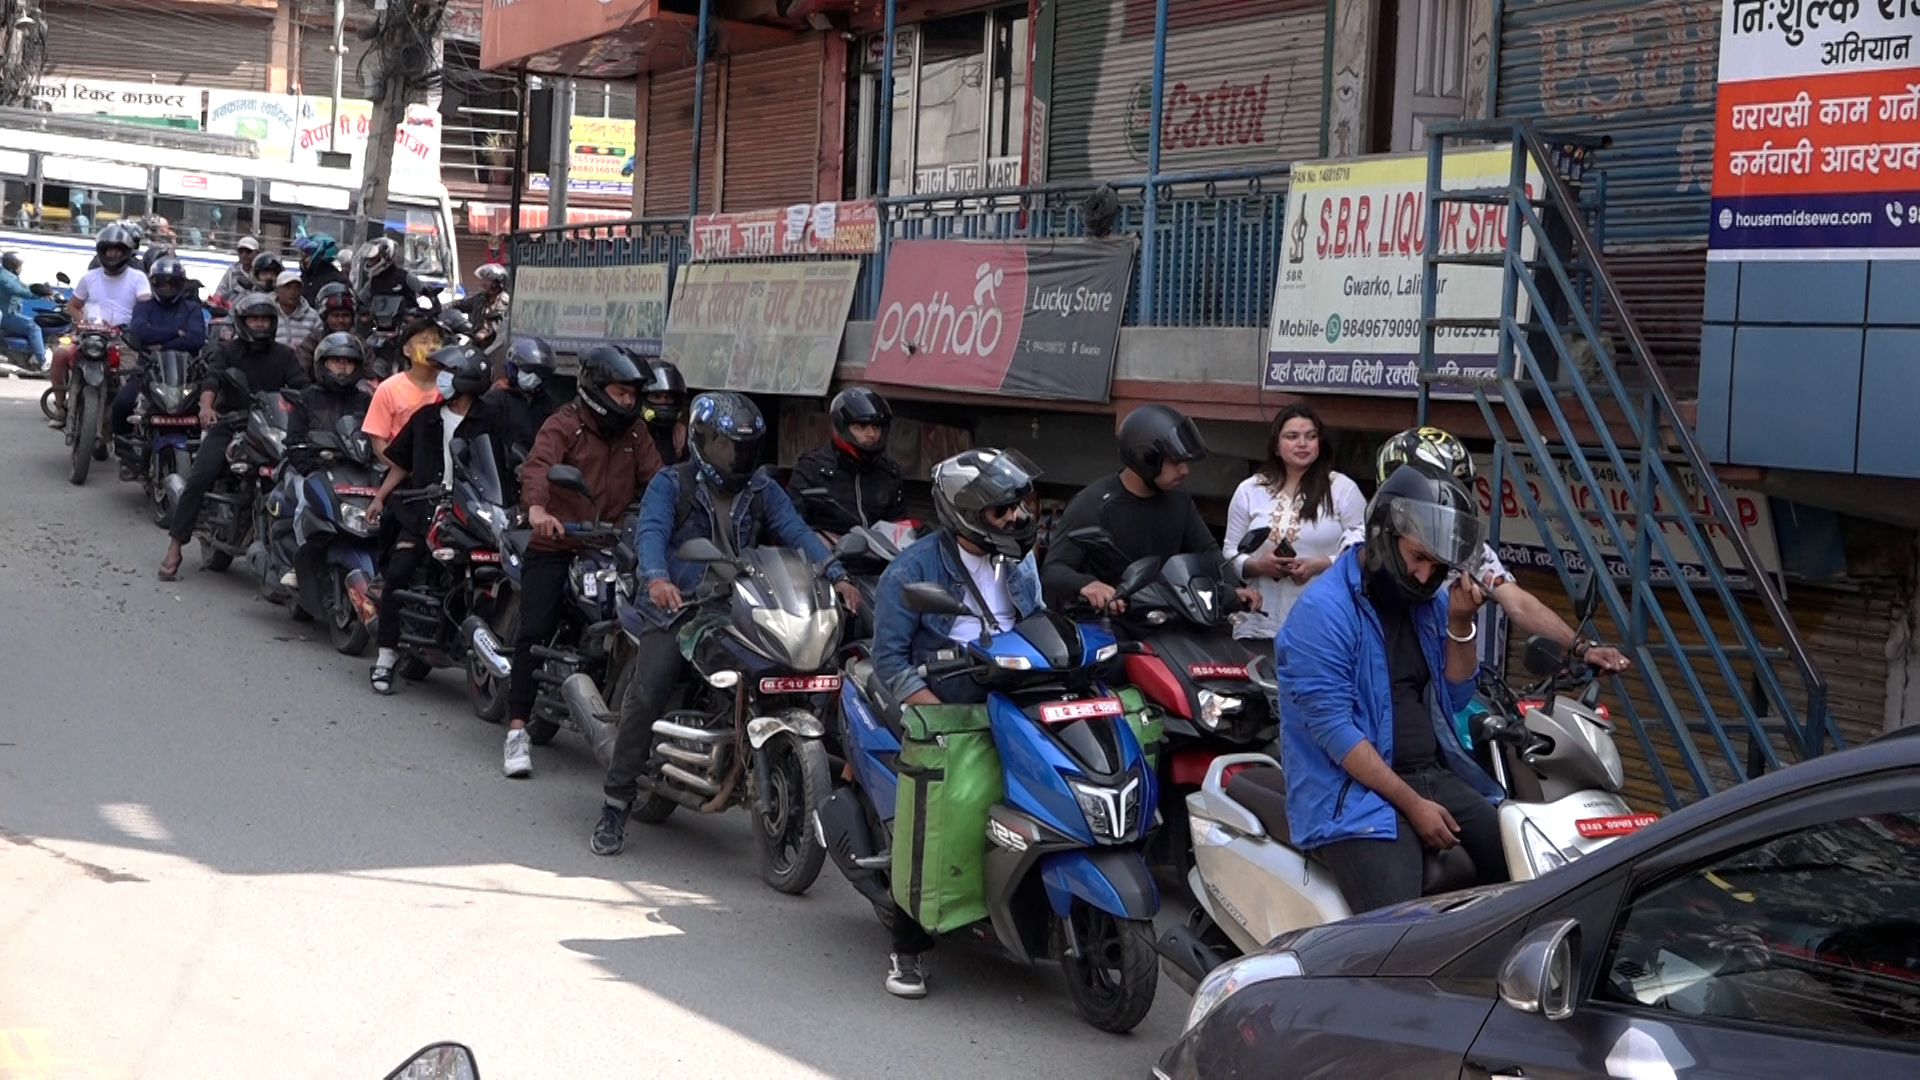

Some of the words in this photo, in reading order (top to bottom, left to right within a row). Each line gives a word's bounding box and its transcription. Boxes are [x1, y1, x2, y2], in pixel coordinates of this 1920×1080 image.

[1820, 31, 1912, 66] अभियान
[1732, 91, 1812, 130] घरायसी
[1819, 96, 1872, 124] काम
[299, 113, 351, 150] नेपाी
[1730, 138, 1814, 176] कर्मचारी
[1316, 194, 1371, 259] S.B.R.
[1378, 188, 1462, 259] LIQUR
[1735, 209, 1873, 227] housemaidsewa.com
[624, 267, 662, 293] Saloon
[1343, 274, 1393, 300] Gwarko,
[1396, 273, 1448, 297] Laliur
[1032, 286, 1076, 318] Lucky
[1073, 285, 1113, 313] Store
[870, 290, 1003, 363] pathao
[1327, 364, 1350, 384] तथा
[1350, 358, 1384, 386] विदेशी
[990, 819, 1028, 852] 125
